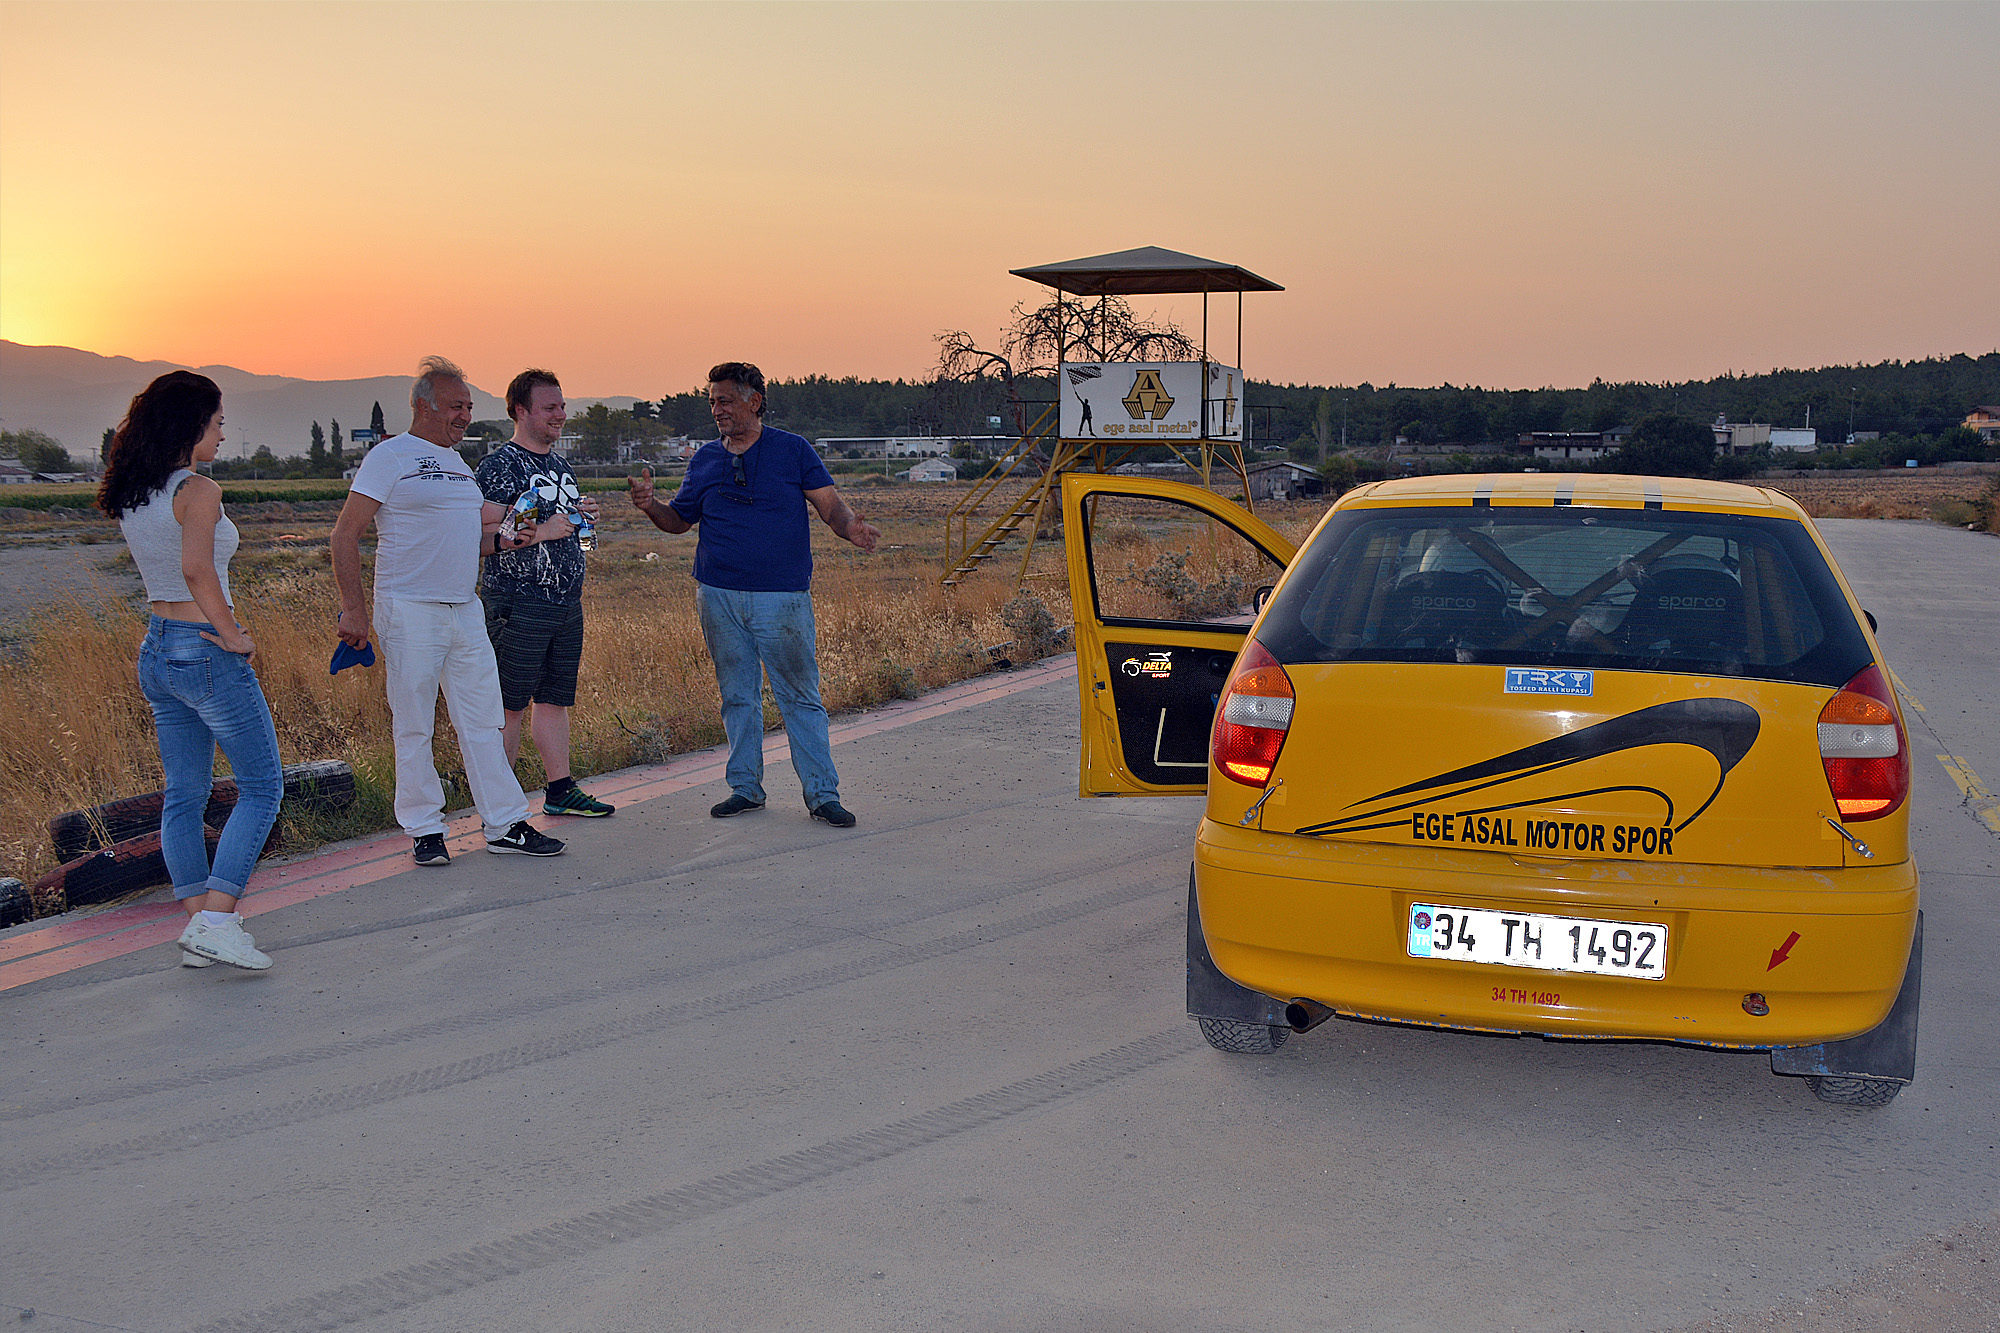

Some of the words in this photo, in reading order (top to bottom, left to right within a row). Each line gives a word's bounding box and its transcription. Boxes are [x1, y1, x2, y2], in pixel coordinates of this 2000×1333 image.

[1103, 423, 1125, 436] ege
[1128, 420, 1153, 433] asal
[1411, 595, 1477, 610] sparco
[1658, 595, 1726, 610] sparco
[1142, 661, 1172, 671] DELTA
[1412, 812, 1455, 842] EGE
[1461, 815, 1518, 846] ASAL
[1525, 820, 1605, 851] MOTOR
[1612, 825, 1674, 855] SPOR
[1415, 933, 1431, 946] TR
[1433, 913, 1476, 952] 34
[1501, 918, 1542, 960] TH
[1568, 925, 1657, 969] 1492
[1491, 986, 1507, 1002] 34
[1509, 988, 1528, 1004] TH
[1531, 991, 1561, 1007] 1492
